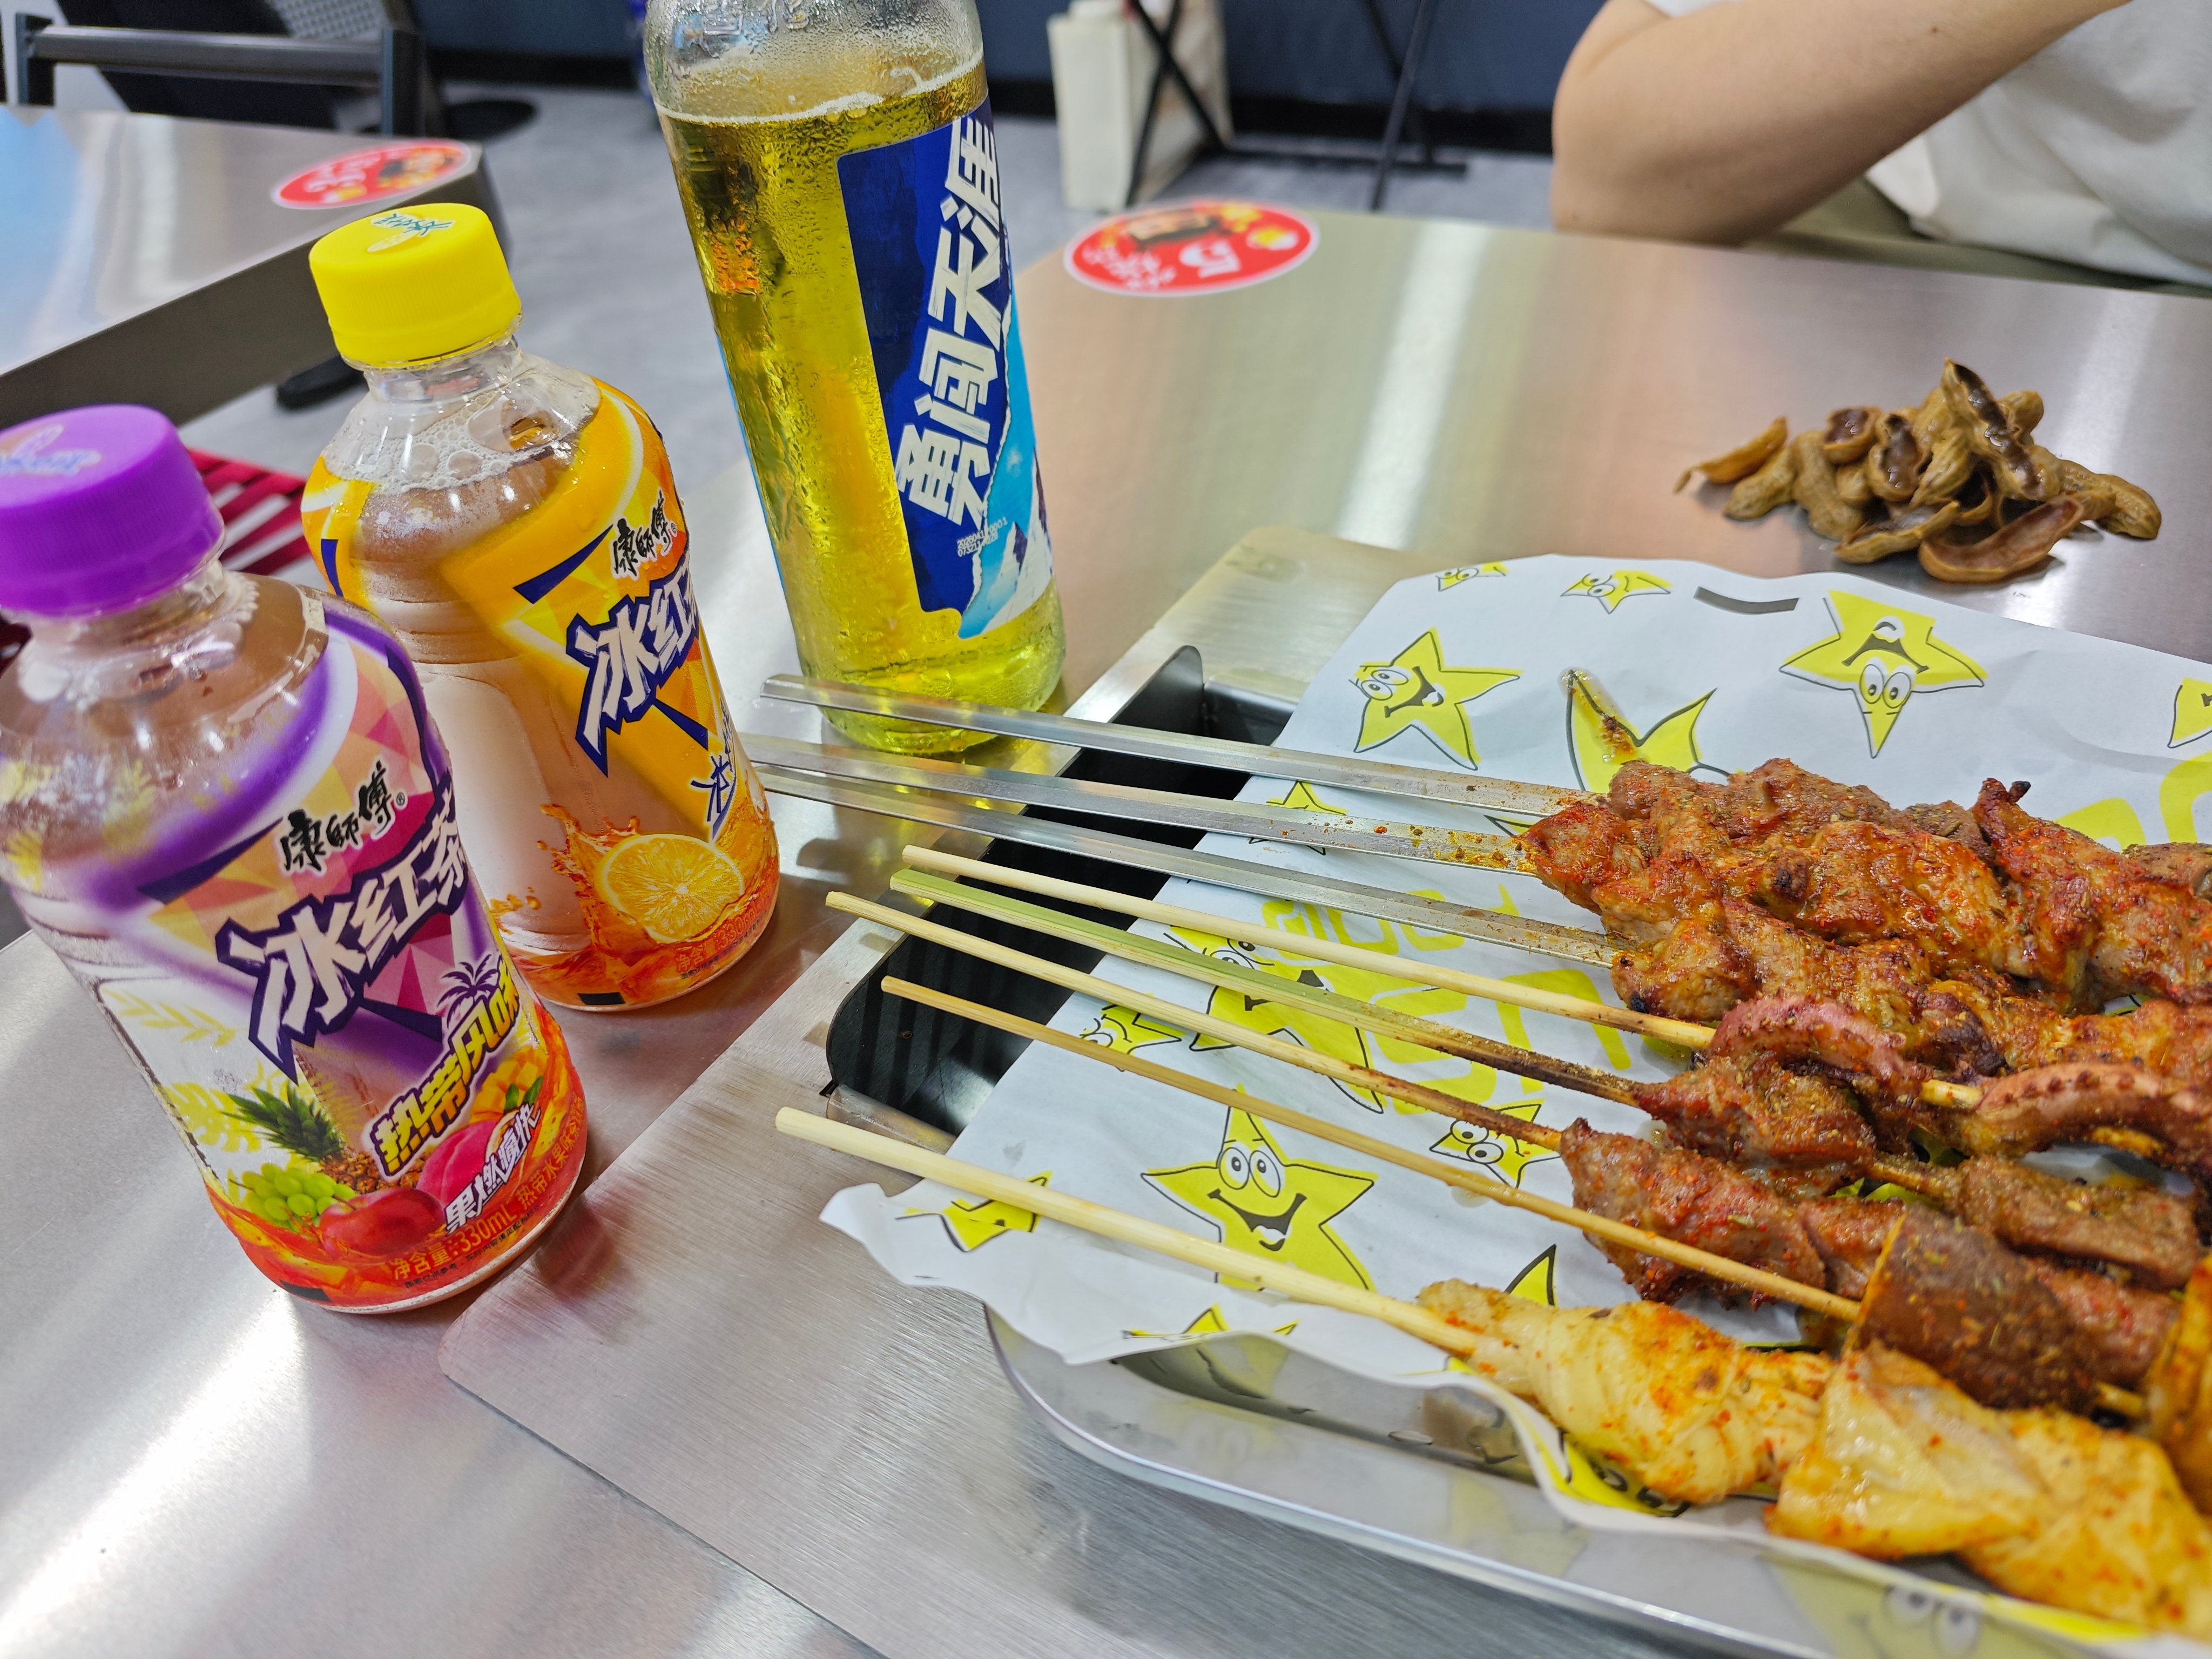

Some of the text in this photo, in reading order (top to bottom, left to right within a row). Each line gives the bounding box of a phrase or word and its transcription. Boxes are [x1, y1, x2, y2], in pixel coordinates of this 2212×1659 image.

[895, 117, 1002, 527] 勇闯天涯
[229, 790, 468, 1062] 冰红茶
[376, 956, 518, 1174] 热带风味
